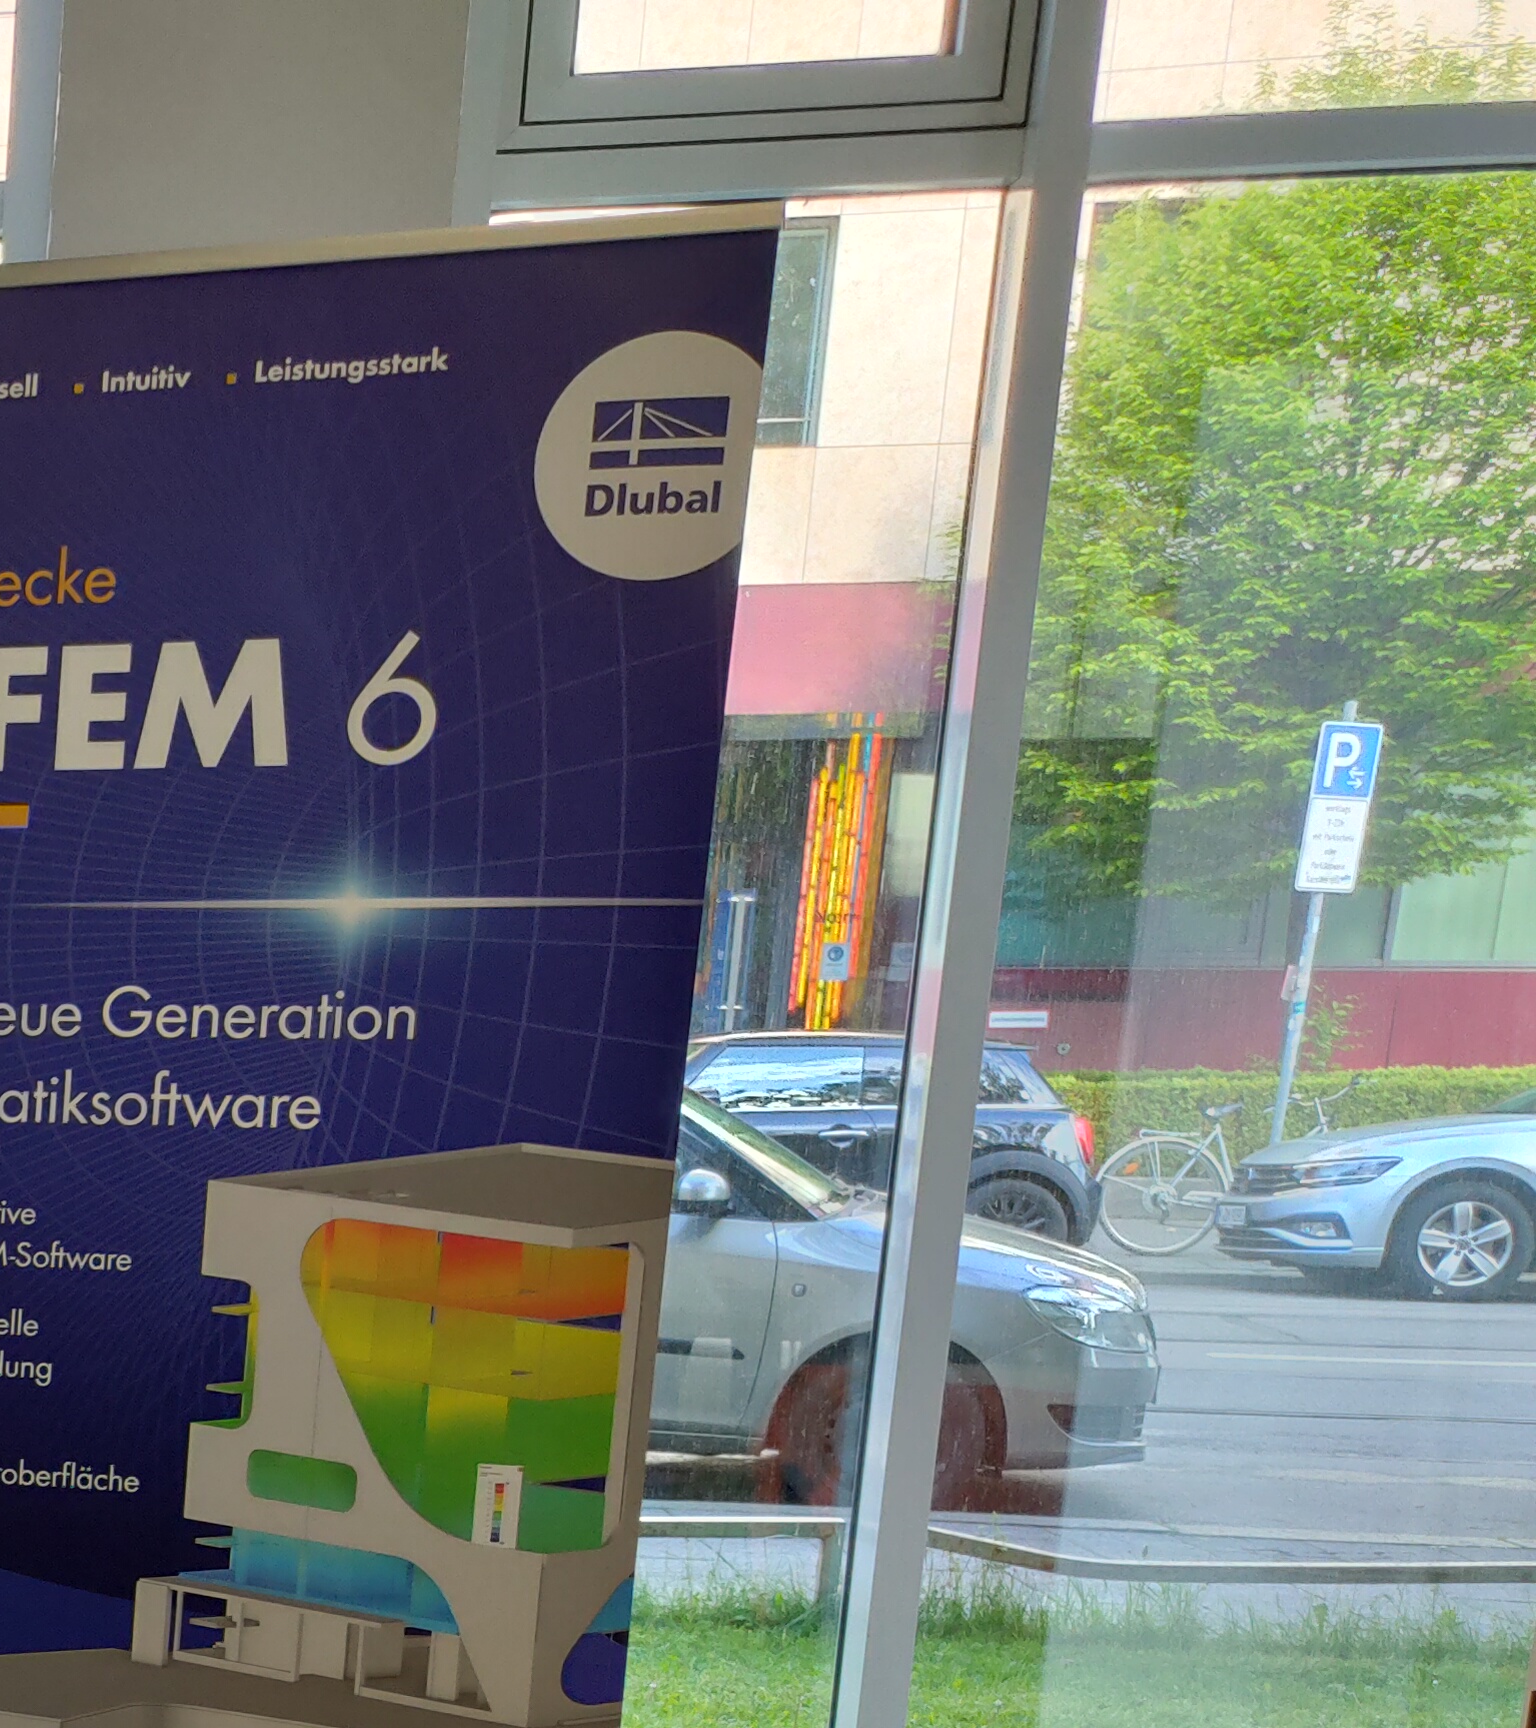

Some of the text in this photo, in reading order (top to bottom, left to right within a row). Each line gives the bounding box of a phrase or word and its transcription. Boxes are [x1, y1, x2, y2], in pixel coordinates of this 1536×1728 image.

[101, 365, 191, 394] Intuitiv
[253, 347, 449, 384] Leistungsstark
[585, 481, 722, 518] Dlubal
[346, 630, 437, 766] 6
[1323, 732, 1361, 788] P
[102, 985, 417, 1040] Generation
